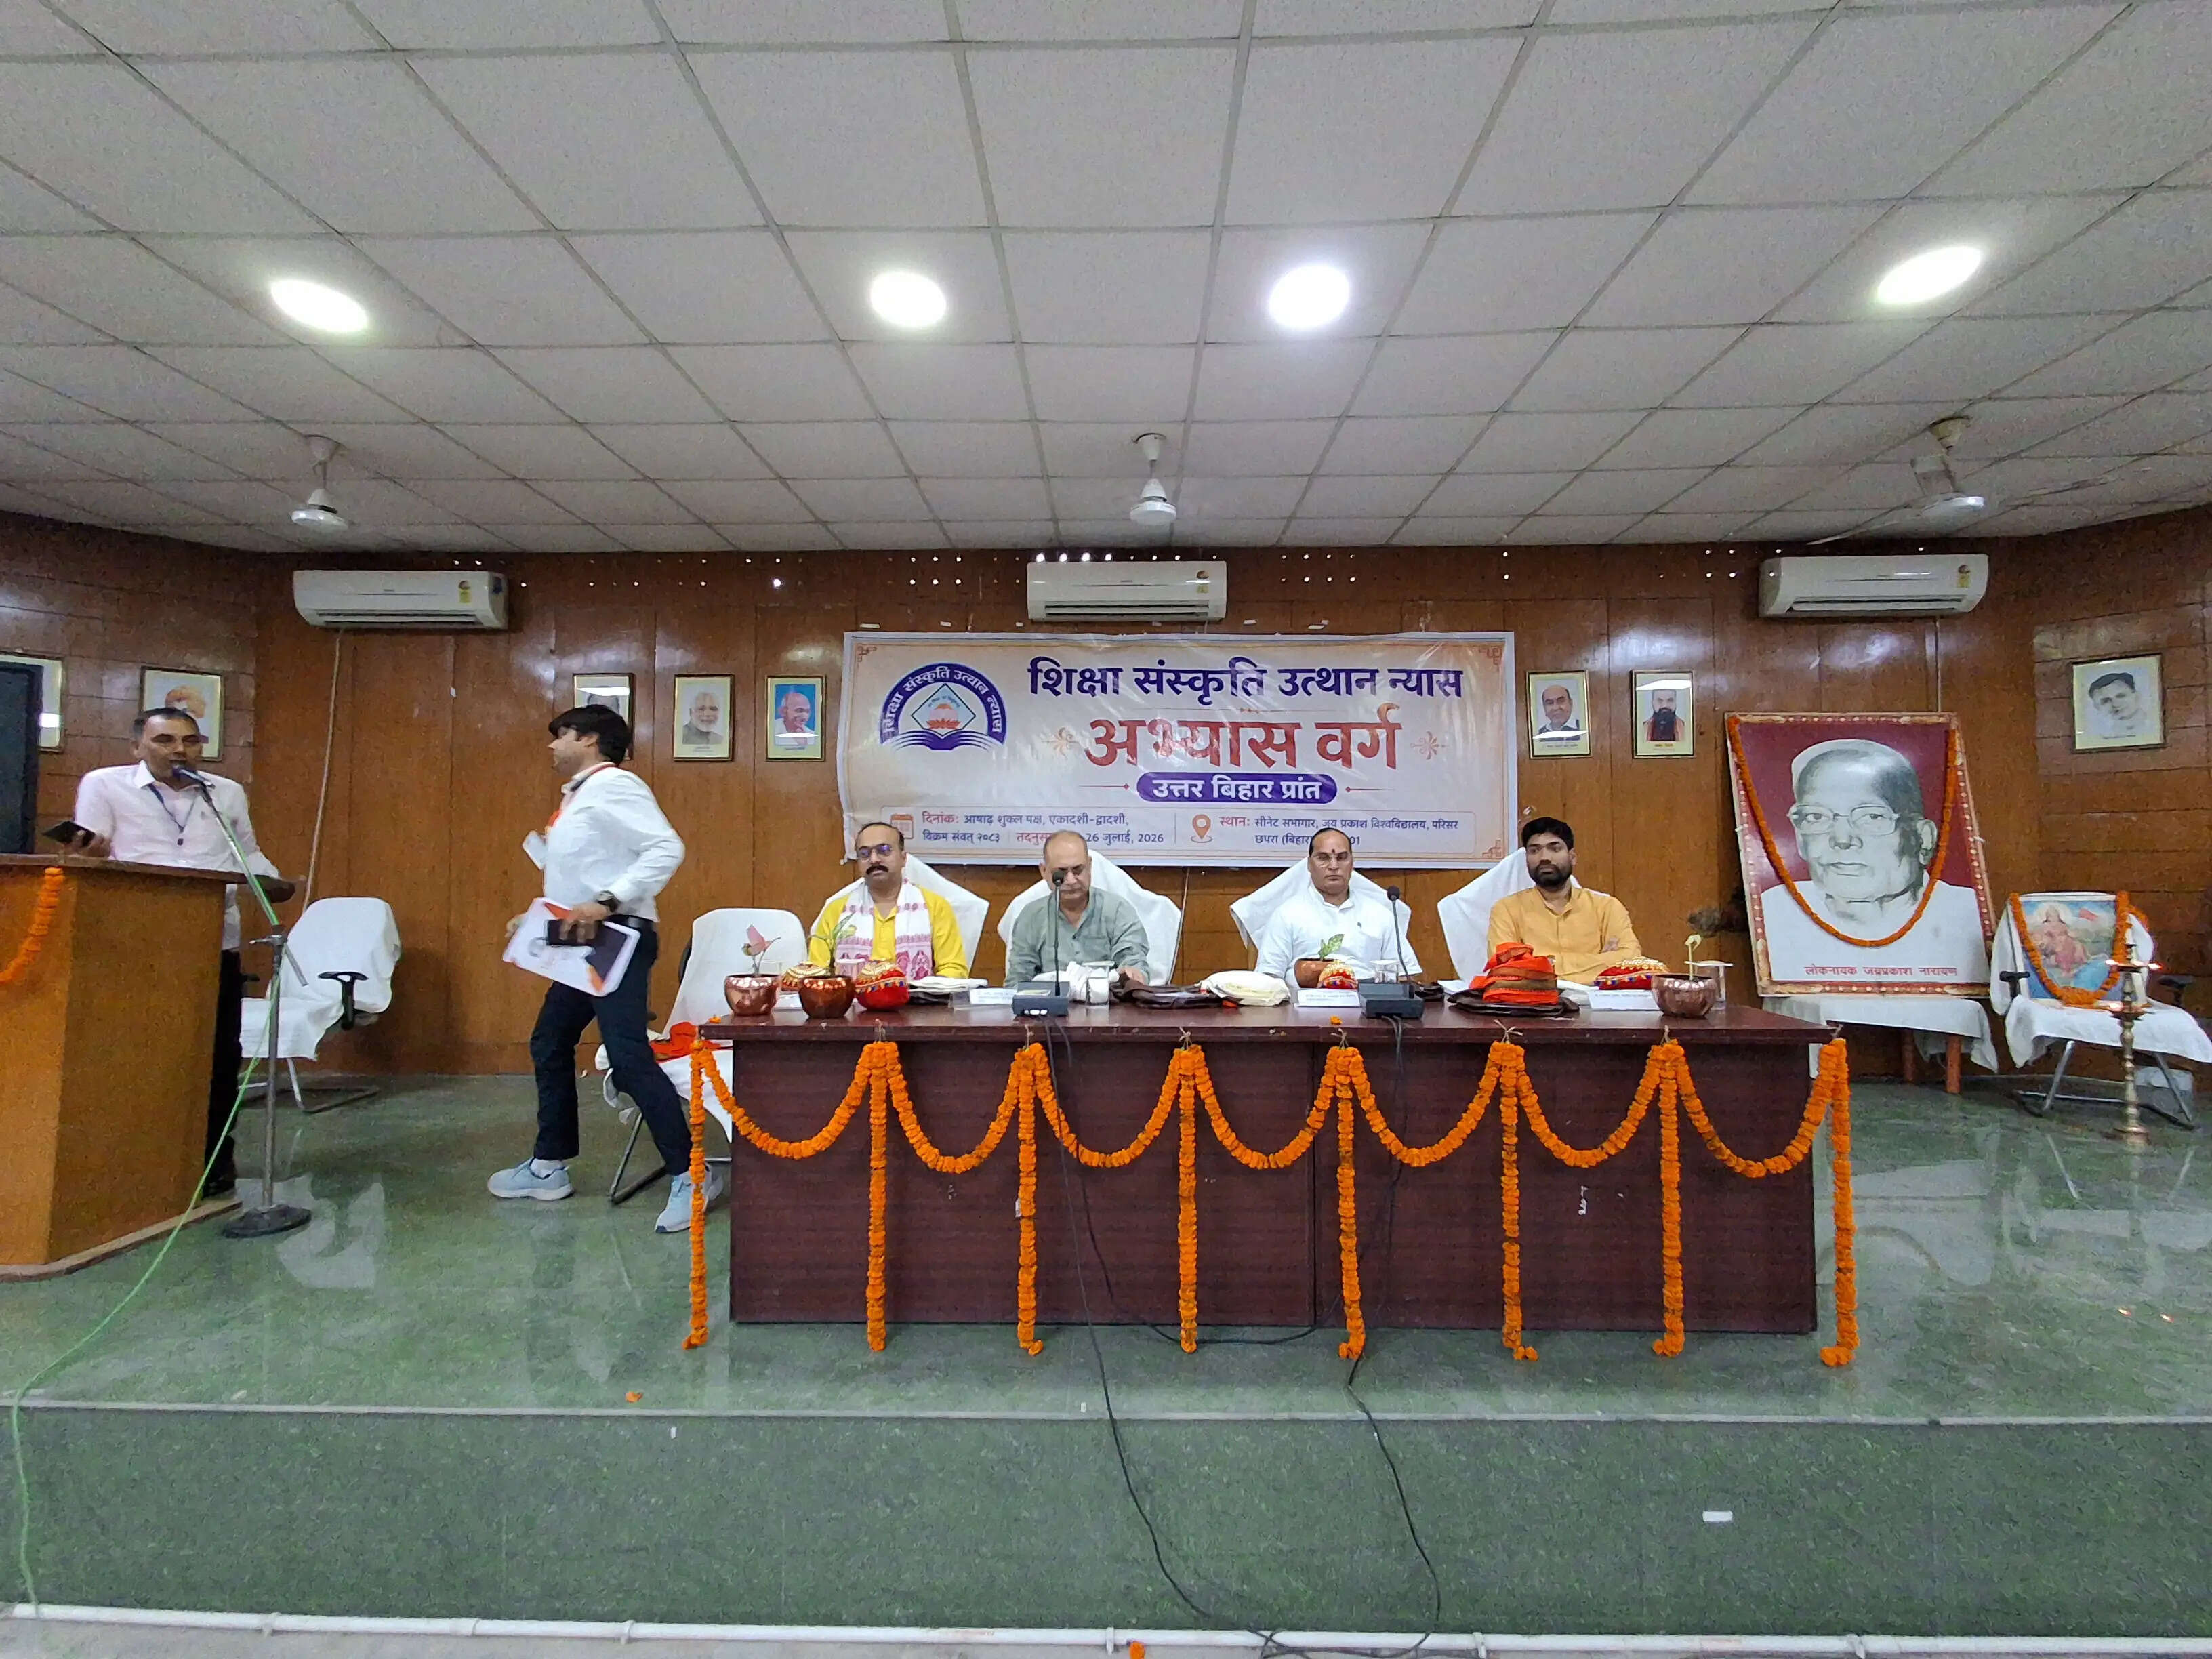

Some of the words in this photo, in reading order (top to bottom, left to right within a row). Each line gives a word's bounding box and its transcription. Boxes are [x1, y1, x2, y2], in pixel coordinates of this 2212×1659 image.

[903, 667, 950, 691] संस्कृति
[1027, 656, 1124, 697] शिक्षा
[1132, 657, 1267, 705] संस्कृति
[1277, 668, 1380, 697] उत्थान
[1387, 668, 1464, 698] न्यास
[1085, 718, 1303, 769] अभ्यास
[1315, 702, 1403, 770] वर्ग
[1151, 779, 1205, 798] उत्तर
[1211, 774, 1274, 802] बिहार
[1280, 776, 1322, 800] प्रांत
[922, 811, 959, 825] दिनांक:
[998, 815, 1022, 827] शुक्ल
[1026, 815, 1046, 826] पक्ष,
[1049, 812, 1129, 826] एकादशी-द्वादशी,
[1220, 816, 1250, 827] स्थान:
[1254, 815, 1279, 827] सीनेट
[1283, 818, 1319, 830] सभागार,
[1340, 819, 1368, 830] प्रकाश
[1371, 817, 1429, 831] विश्वविद्यालय,
[1432, 818, 1459, 830] परिसर
[922, 830, 949, 842] विक्रम
[951, 829, 975, 844] संवत्
[977, 832, 1000, 843] २०८३
[1017, 832, 1052, 844] तदनुस
[1086, 833, 1099, 842] 26
[1103, 830, 1134, 845] जुलाई,
[1138, 834, 1164, 843] 2026
[1255, 834, 1279, 844] छपरा
[1282, 832, 1312, 846] (बिहार
